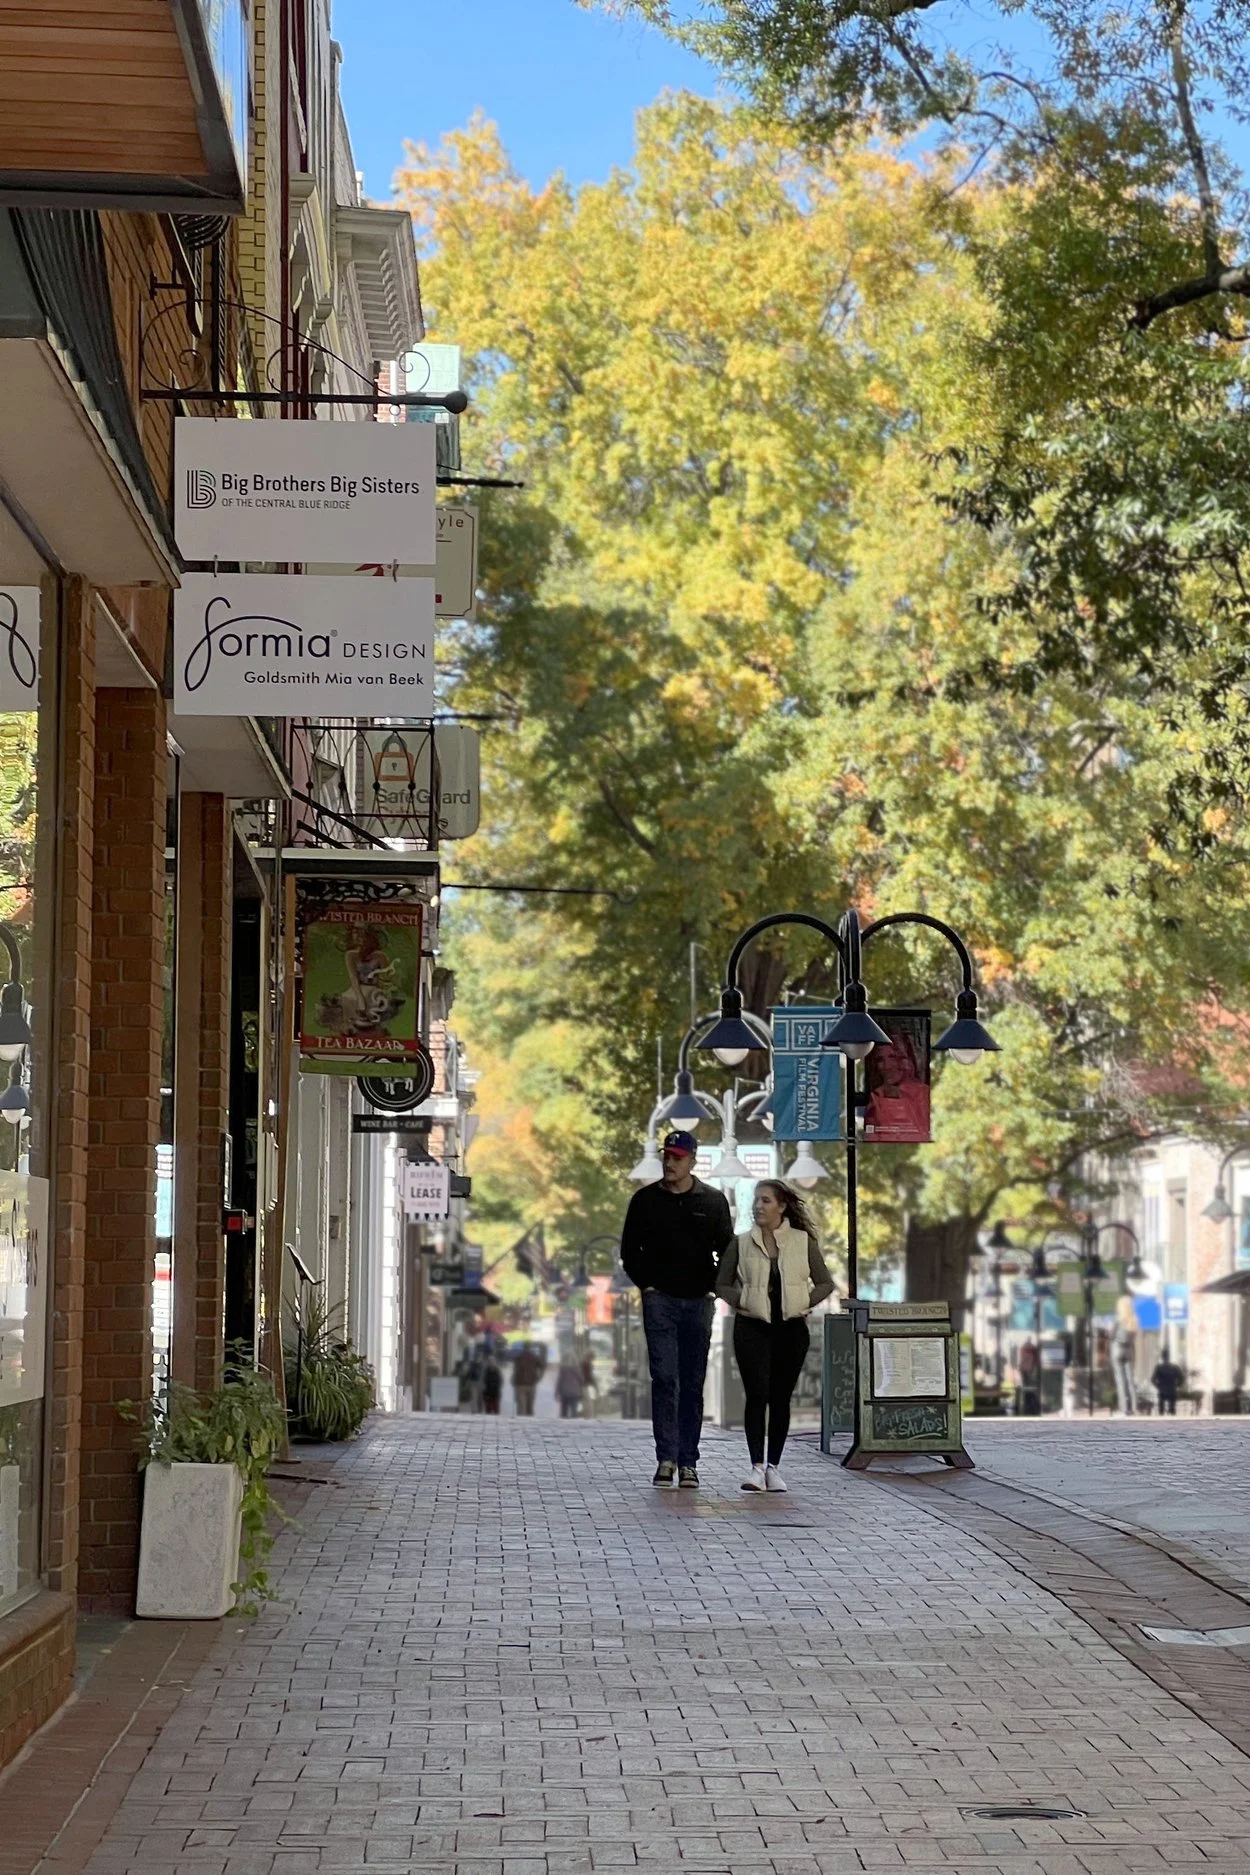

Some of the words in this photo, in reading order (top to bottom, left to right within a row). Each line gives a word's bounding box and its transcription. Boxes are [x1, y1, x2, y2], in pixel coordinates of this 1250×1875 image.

[221, 473, 248, 495] Big
[253, 474, 326, 493] Brothers
[330, 476, 357, 498] Big
[361, 476, 420, 494] Sisters
[221, 498, 234, 508] OF
[236, 498, 253, 508] THE
[255, 499, 296, 509] CENTRAL
[298, 499, 322, 509] BLUE
[323, 500, 351, 510] RIDGE
[343, 643, 426, 659] DESIGN
[244, 671, 320, 685] Goldsmith
[325, 673, 352, 685] Mia
[357, 676, 384, 685] van
[389, 673, 424, 686] Beek
[377, 788, 471, 805] SafeGard
[367, 912, 418, 925] BRANCH
[797, 1025, 817, 1035] VA
[315, 1036, 342, 1049] TEA
[346, 1037, 404, 1051] BAZAAR
[797, 1035, 816, 1045] FF
[797, 1057, 807, 1082] FILM
[806, 1057, 820, 1132] VIRGINIA
[797, 1084, 807, 1133] FESTIVAL
[360, 1120, 381, 1129] WINE
[383, 1120, 398, 1129] BAR
[410, 1186, 442, 1199] LEASE
